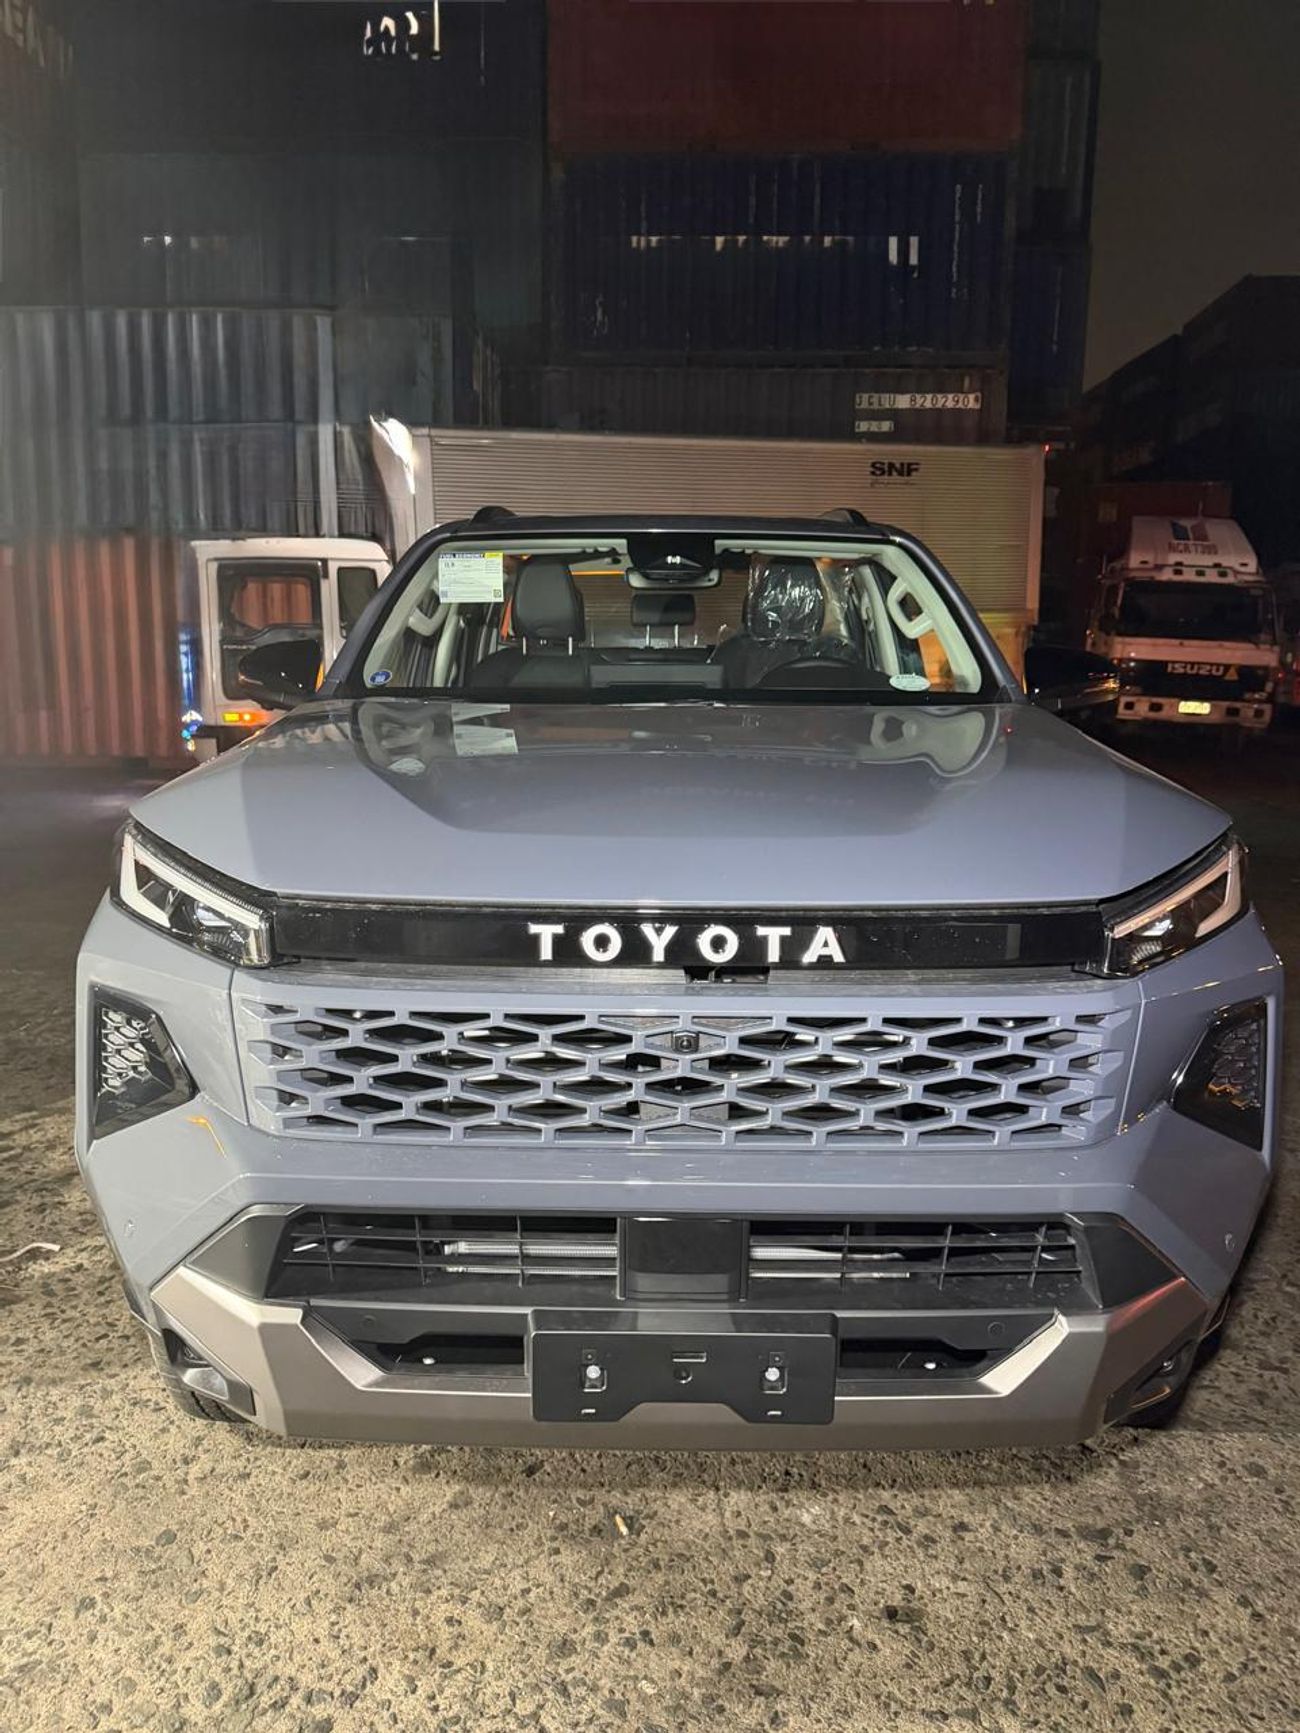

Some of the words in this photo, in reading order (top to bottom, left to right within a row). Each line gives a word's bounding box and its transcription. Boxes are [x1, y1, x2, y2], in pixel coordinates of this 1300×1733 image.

[871, 462, 920, 476] SNF
[1167, 662, 1225, 676] ISUZU
[528, 923, 846, 963] TOYOTA
